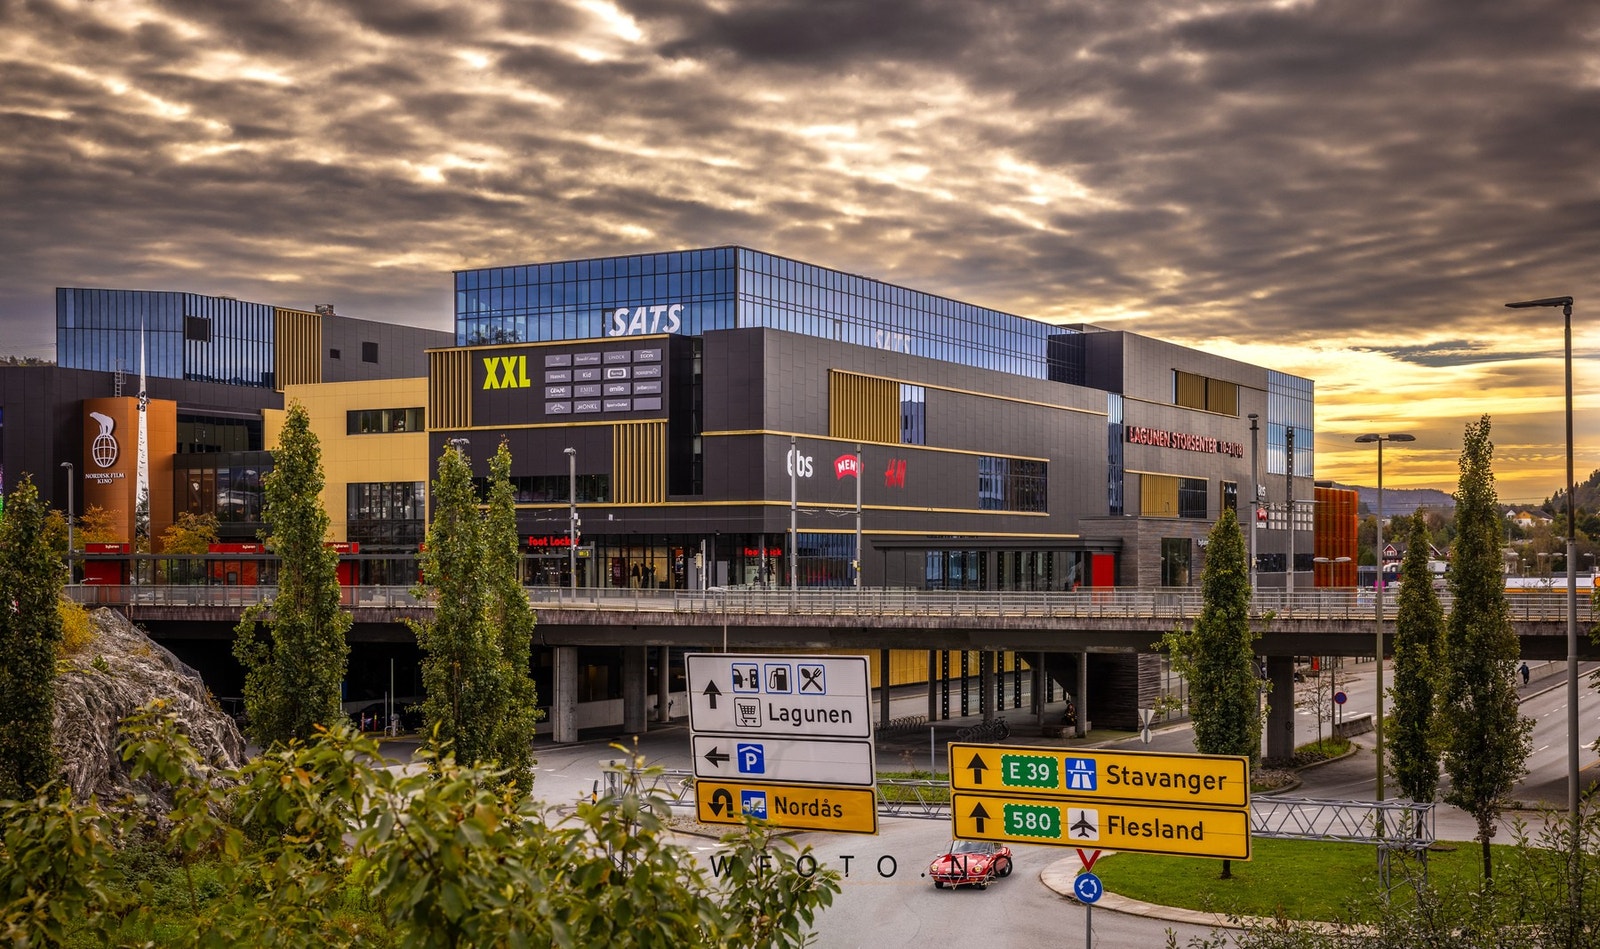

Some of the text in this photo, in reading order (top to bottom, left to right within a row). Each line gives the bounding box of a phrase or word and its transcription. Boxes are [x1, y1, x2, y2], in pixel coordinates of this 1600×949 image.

[608, 304, 684, 337] SATS
[483, 355, 531, 390] XXL
[1130, 425, 1171, 448] LAGUNEN
[1172, 431, 1218, 454] STORSENTER
[837, 459, 858, 474] MEN
[884, 458, 907, 488] H&M
[550, 535, 580, 546] Lockr
[769, 703, 852, 727] Lagunen
[1009, 762, 1227, 795] E 39 Stavanger
[774, 796, 843, 818] Nordås
[1012, 811, 1204, 841] 580 Flesland
